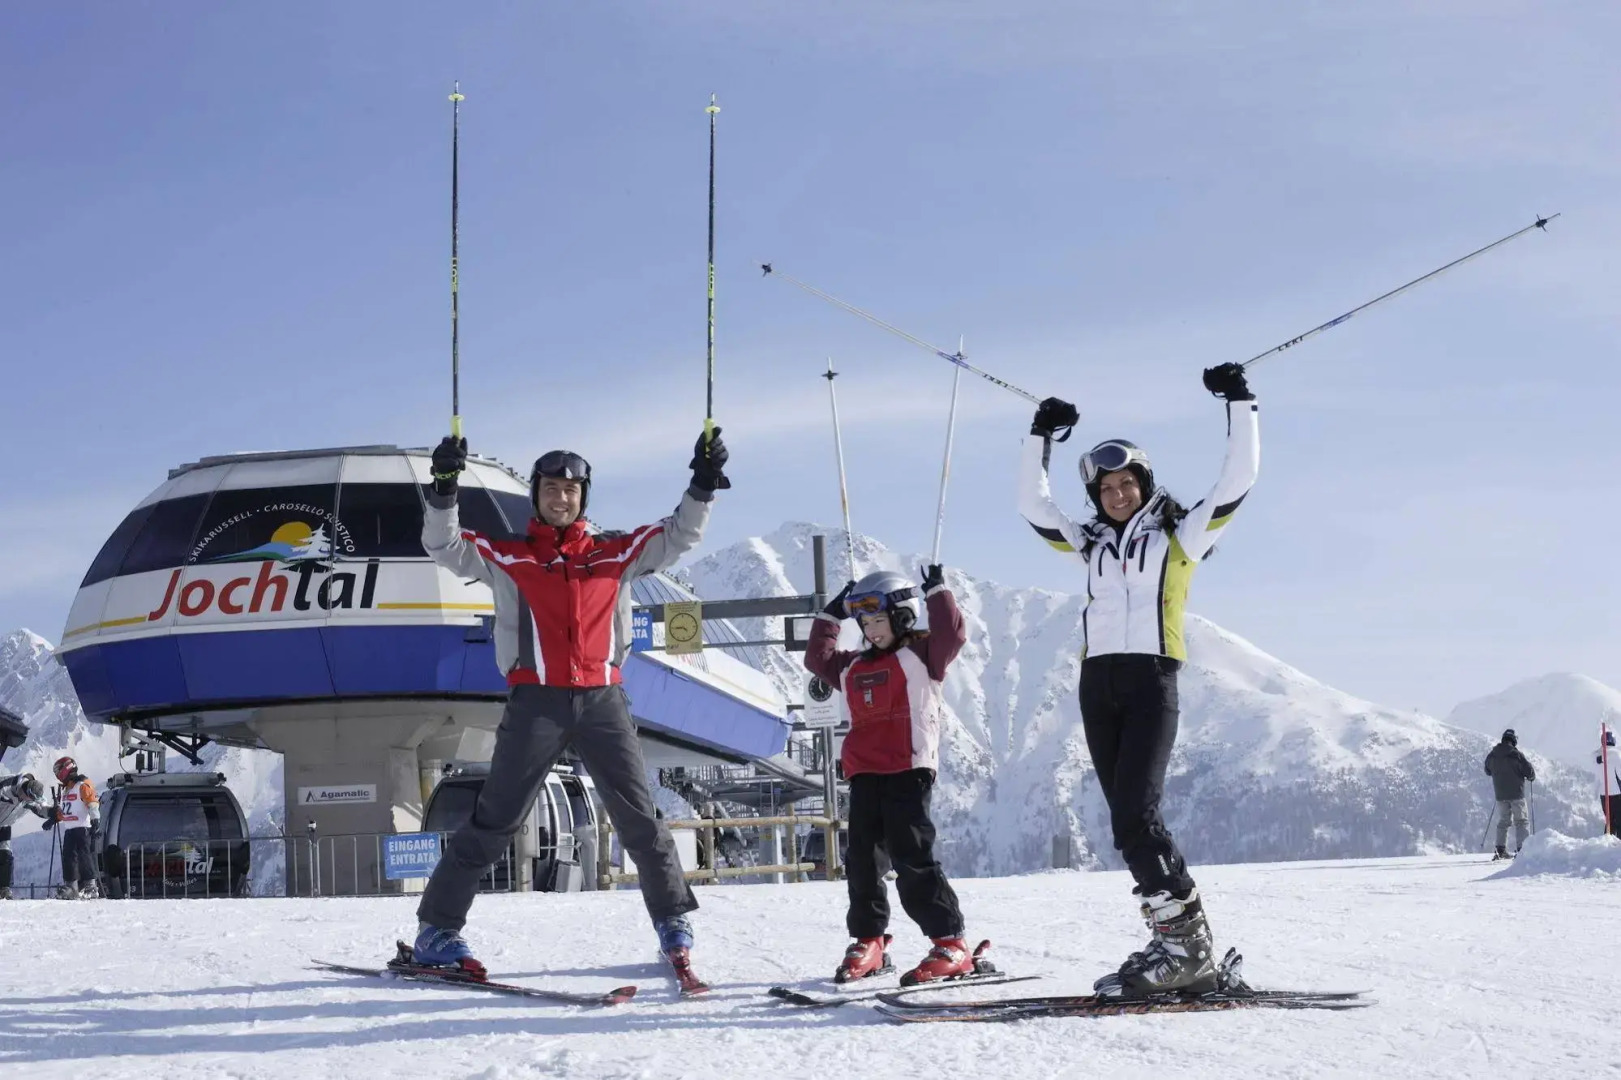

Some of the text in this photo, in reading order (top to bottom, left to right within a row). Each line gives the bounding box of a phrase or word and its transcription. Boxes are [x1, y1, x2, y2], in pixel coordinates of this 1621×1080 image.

[189, 511, 253, 563] SKIKARUSSELL
[264, 503, 325, 516] CAROSELLO
[148, 558, 380, 622] Jochtal
[320, 789, 370, 800] Agamatic
[388, 839, 436, 853] EINGANG
[390, 852, 436, 866] ENTRATA
